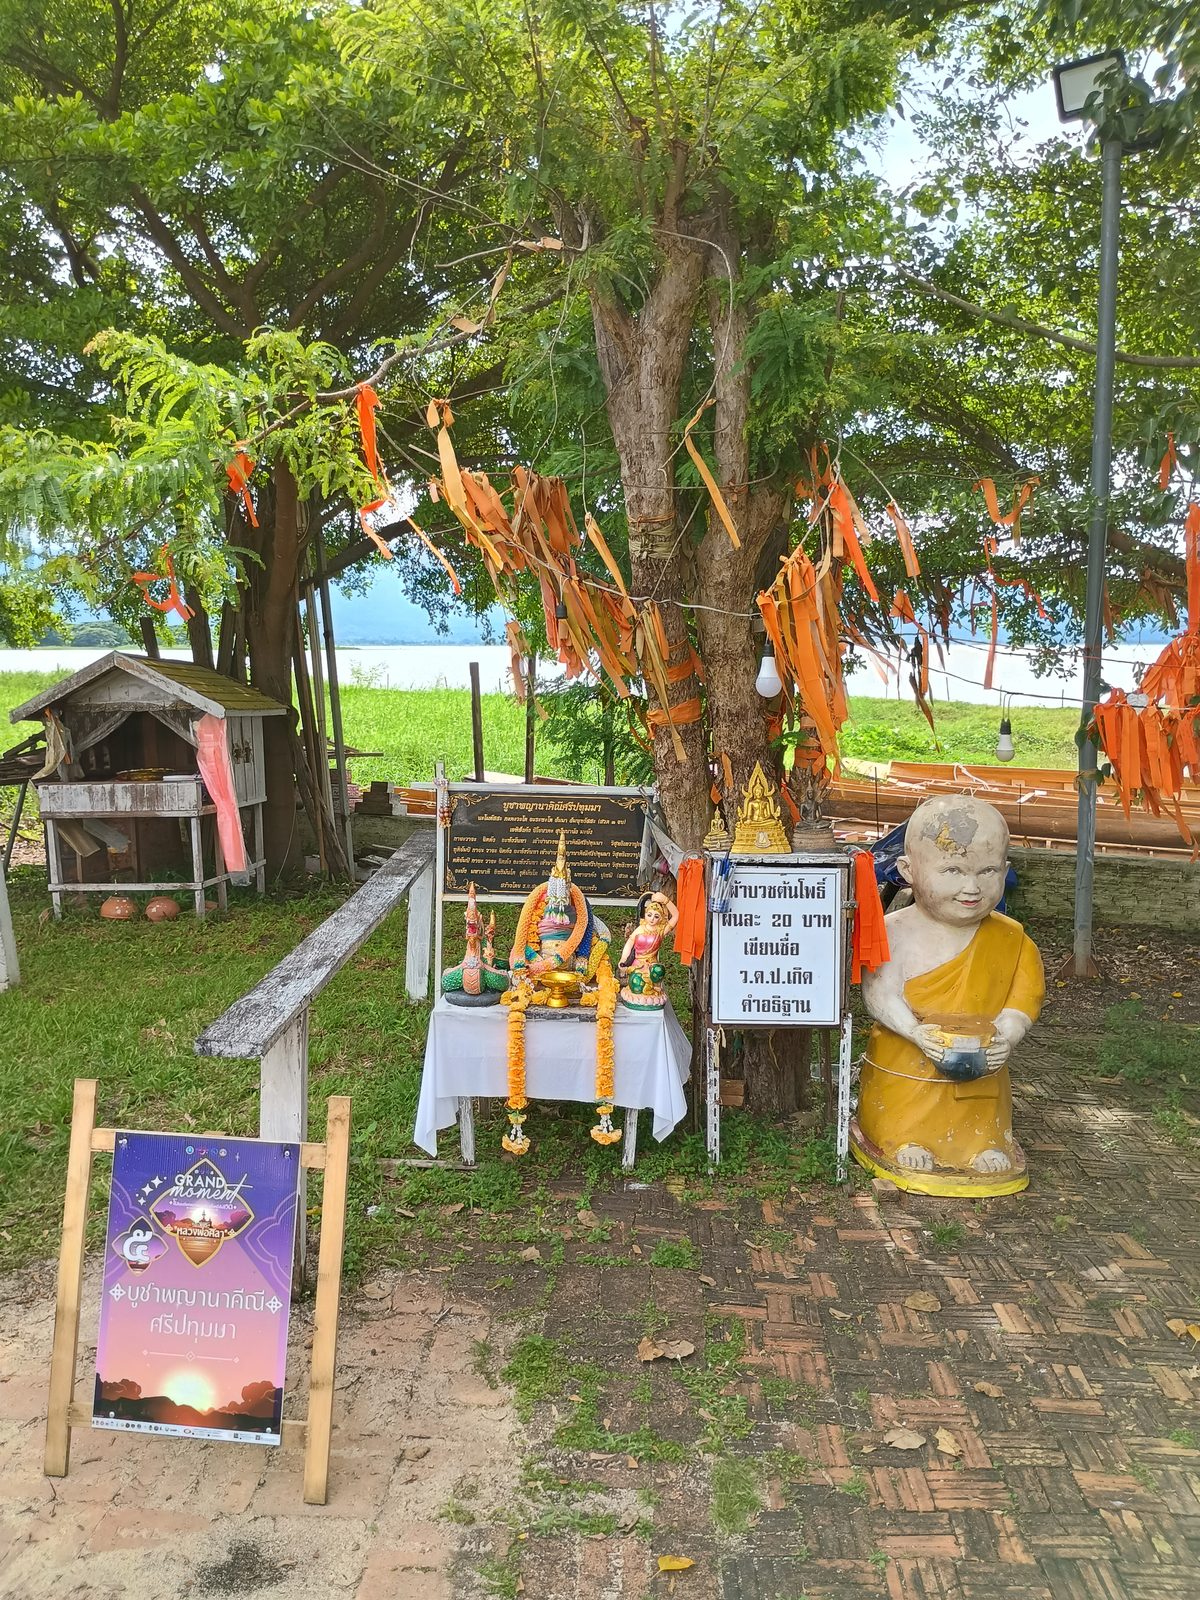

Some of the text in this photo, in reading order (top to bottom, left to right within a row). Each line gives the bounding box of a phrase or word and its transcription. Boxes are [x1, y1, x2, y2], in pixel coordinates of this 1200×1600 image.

[771, 914, 792, 928] 20
[802, 914, 833, 928] บาท
[743, 932, 800, 956] เขียนชื่อ
[739, 966, 813, 985] ว.ด.ป.เกิด
[741, 993, 812, 1017] คำอธิฐาน
[169, 1173, 253, 1203] moment
[174, 1173, 226, 1189] GRAND
[127, 1283, 266, 1312] บูชาพญานาคีณี
[149, 1312, 237, 1343] ศรีปทุมมา
